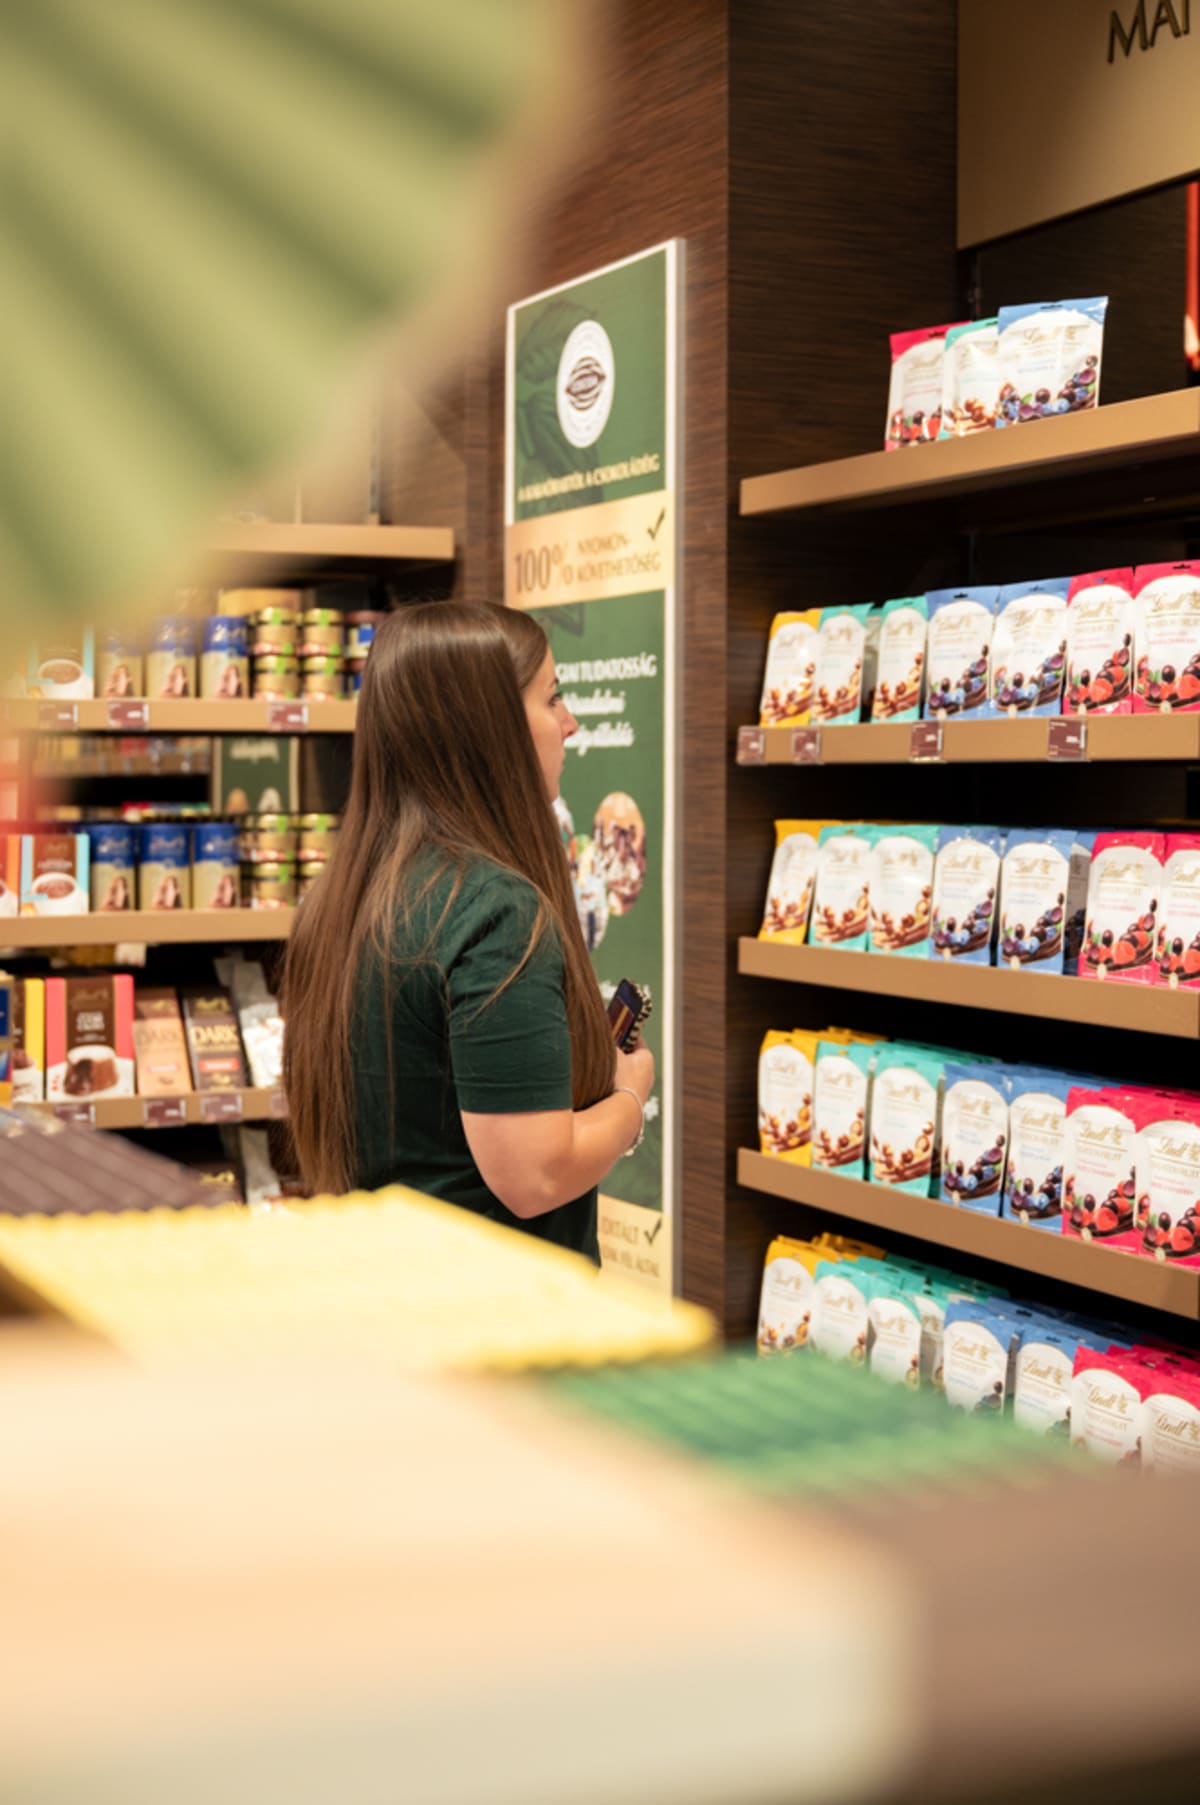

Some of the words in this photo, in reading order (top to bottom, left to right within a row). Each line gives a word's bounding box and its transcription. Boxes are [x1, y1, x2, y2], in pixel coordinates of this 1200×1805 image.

[514, 541, 574, 594] 100%
[191, 1025, 238, 1044] DARK
[1157, 1412, 1190, 1436] Lindt
